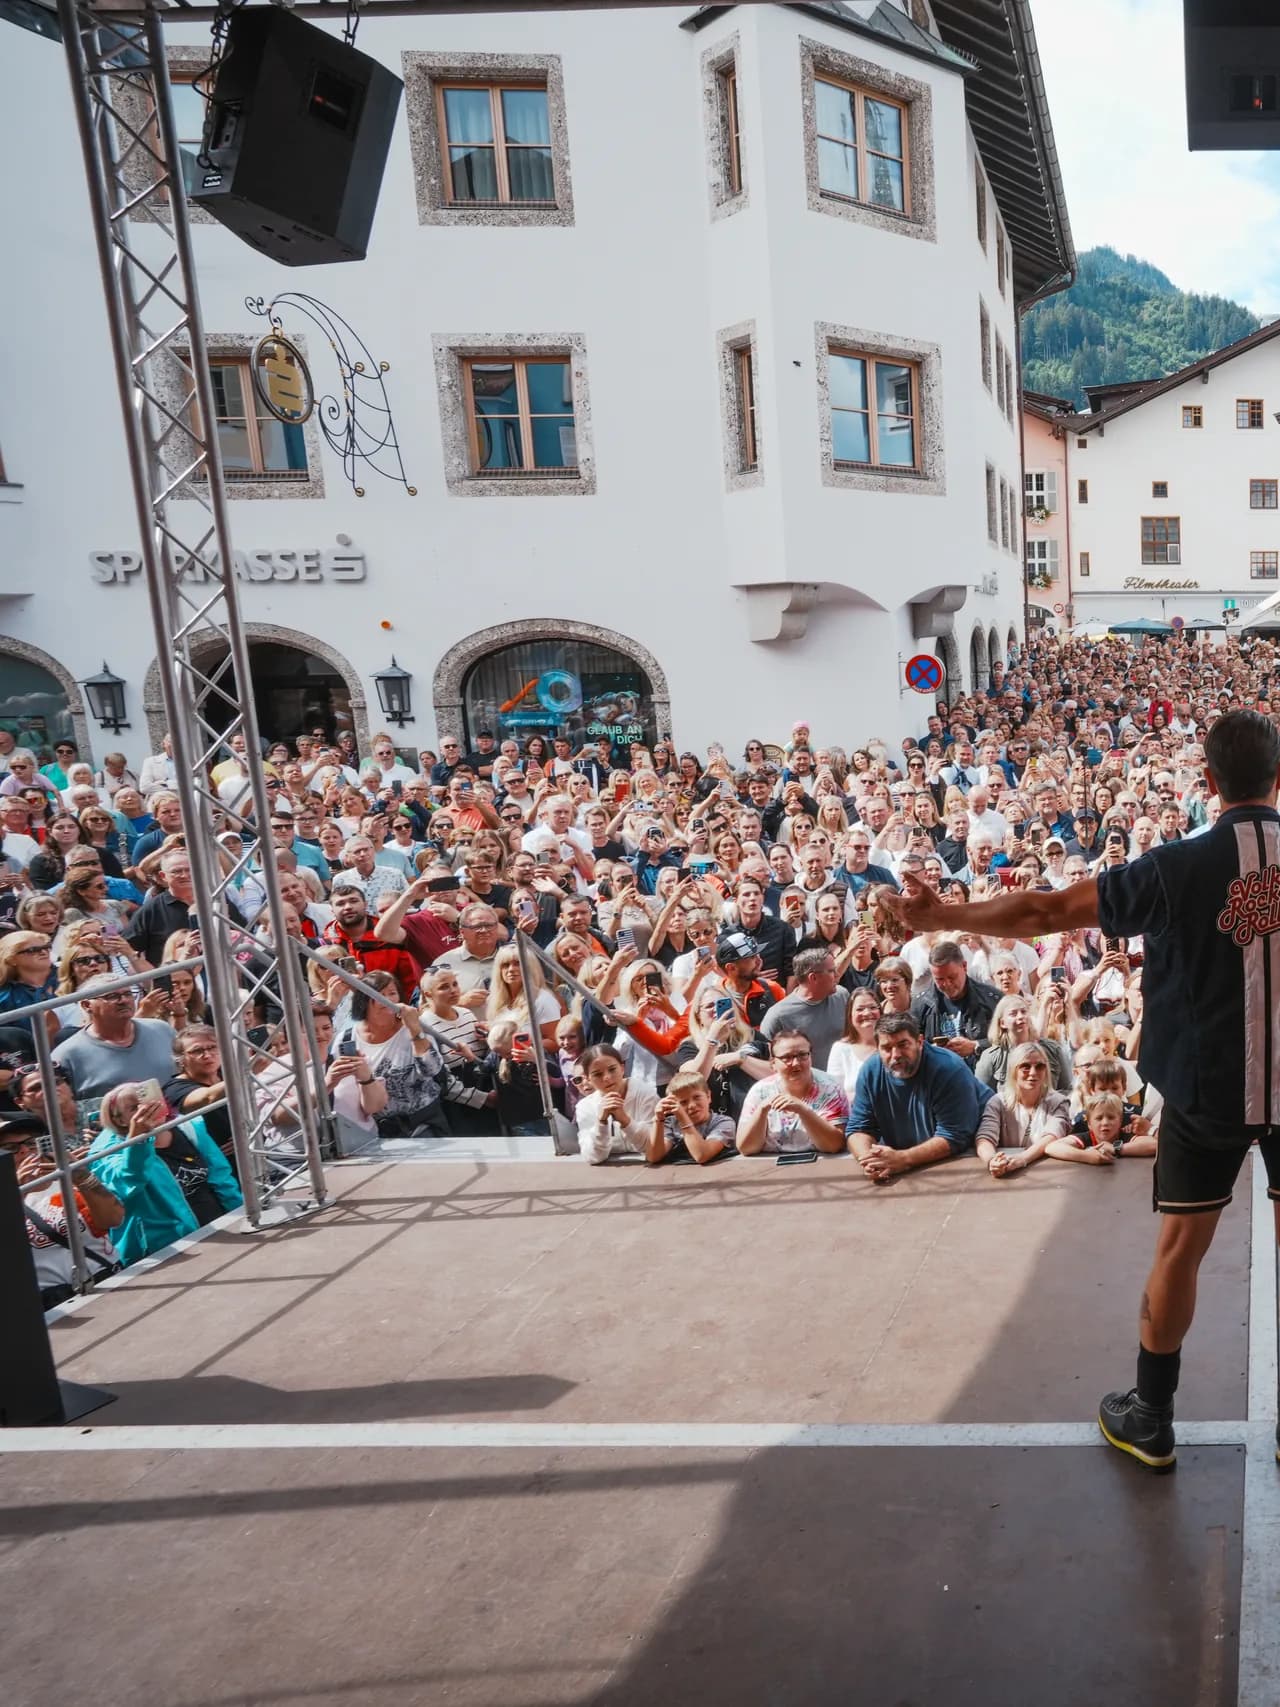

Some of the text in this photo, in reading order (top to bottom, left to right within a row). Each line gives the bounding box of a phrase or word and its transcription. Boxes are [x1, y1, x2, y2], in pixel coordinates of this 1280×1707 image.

[88, 549, 323, 584] SPRKASSE
[1123, 577, 1200, 589] Filmtheater
[587, 725, 642, 735] GLAUB AN
